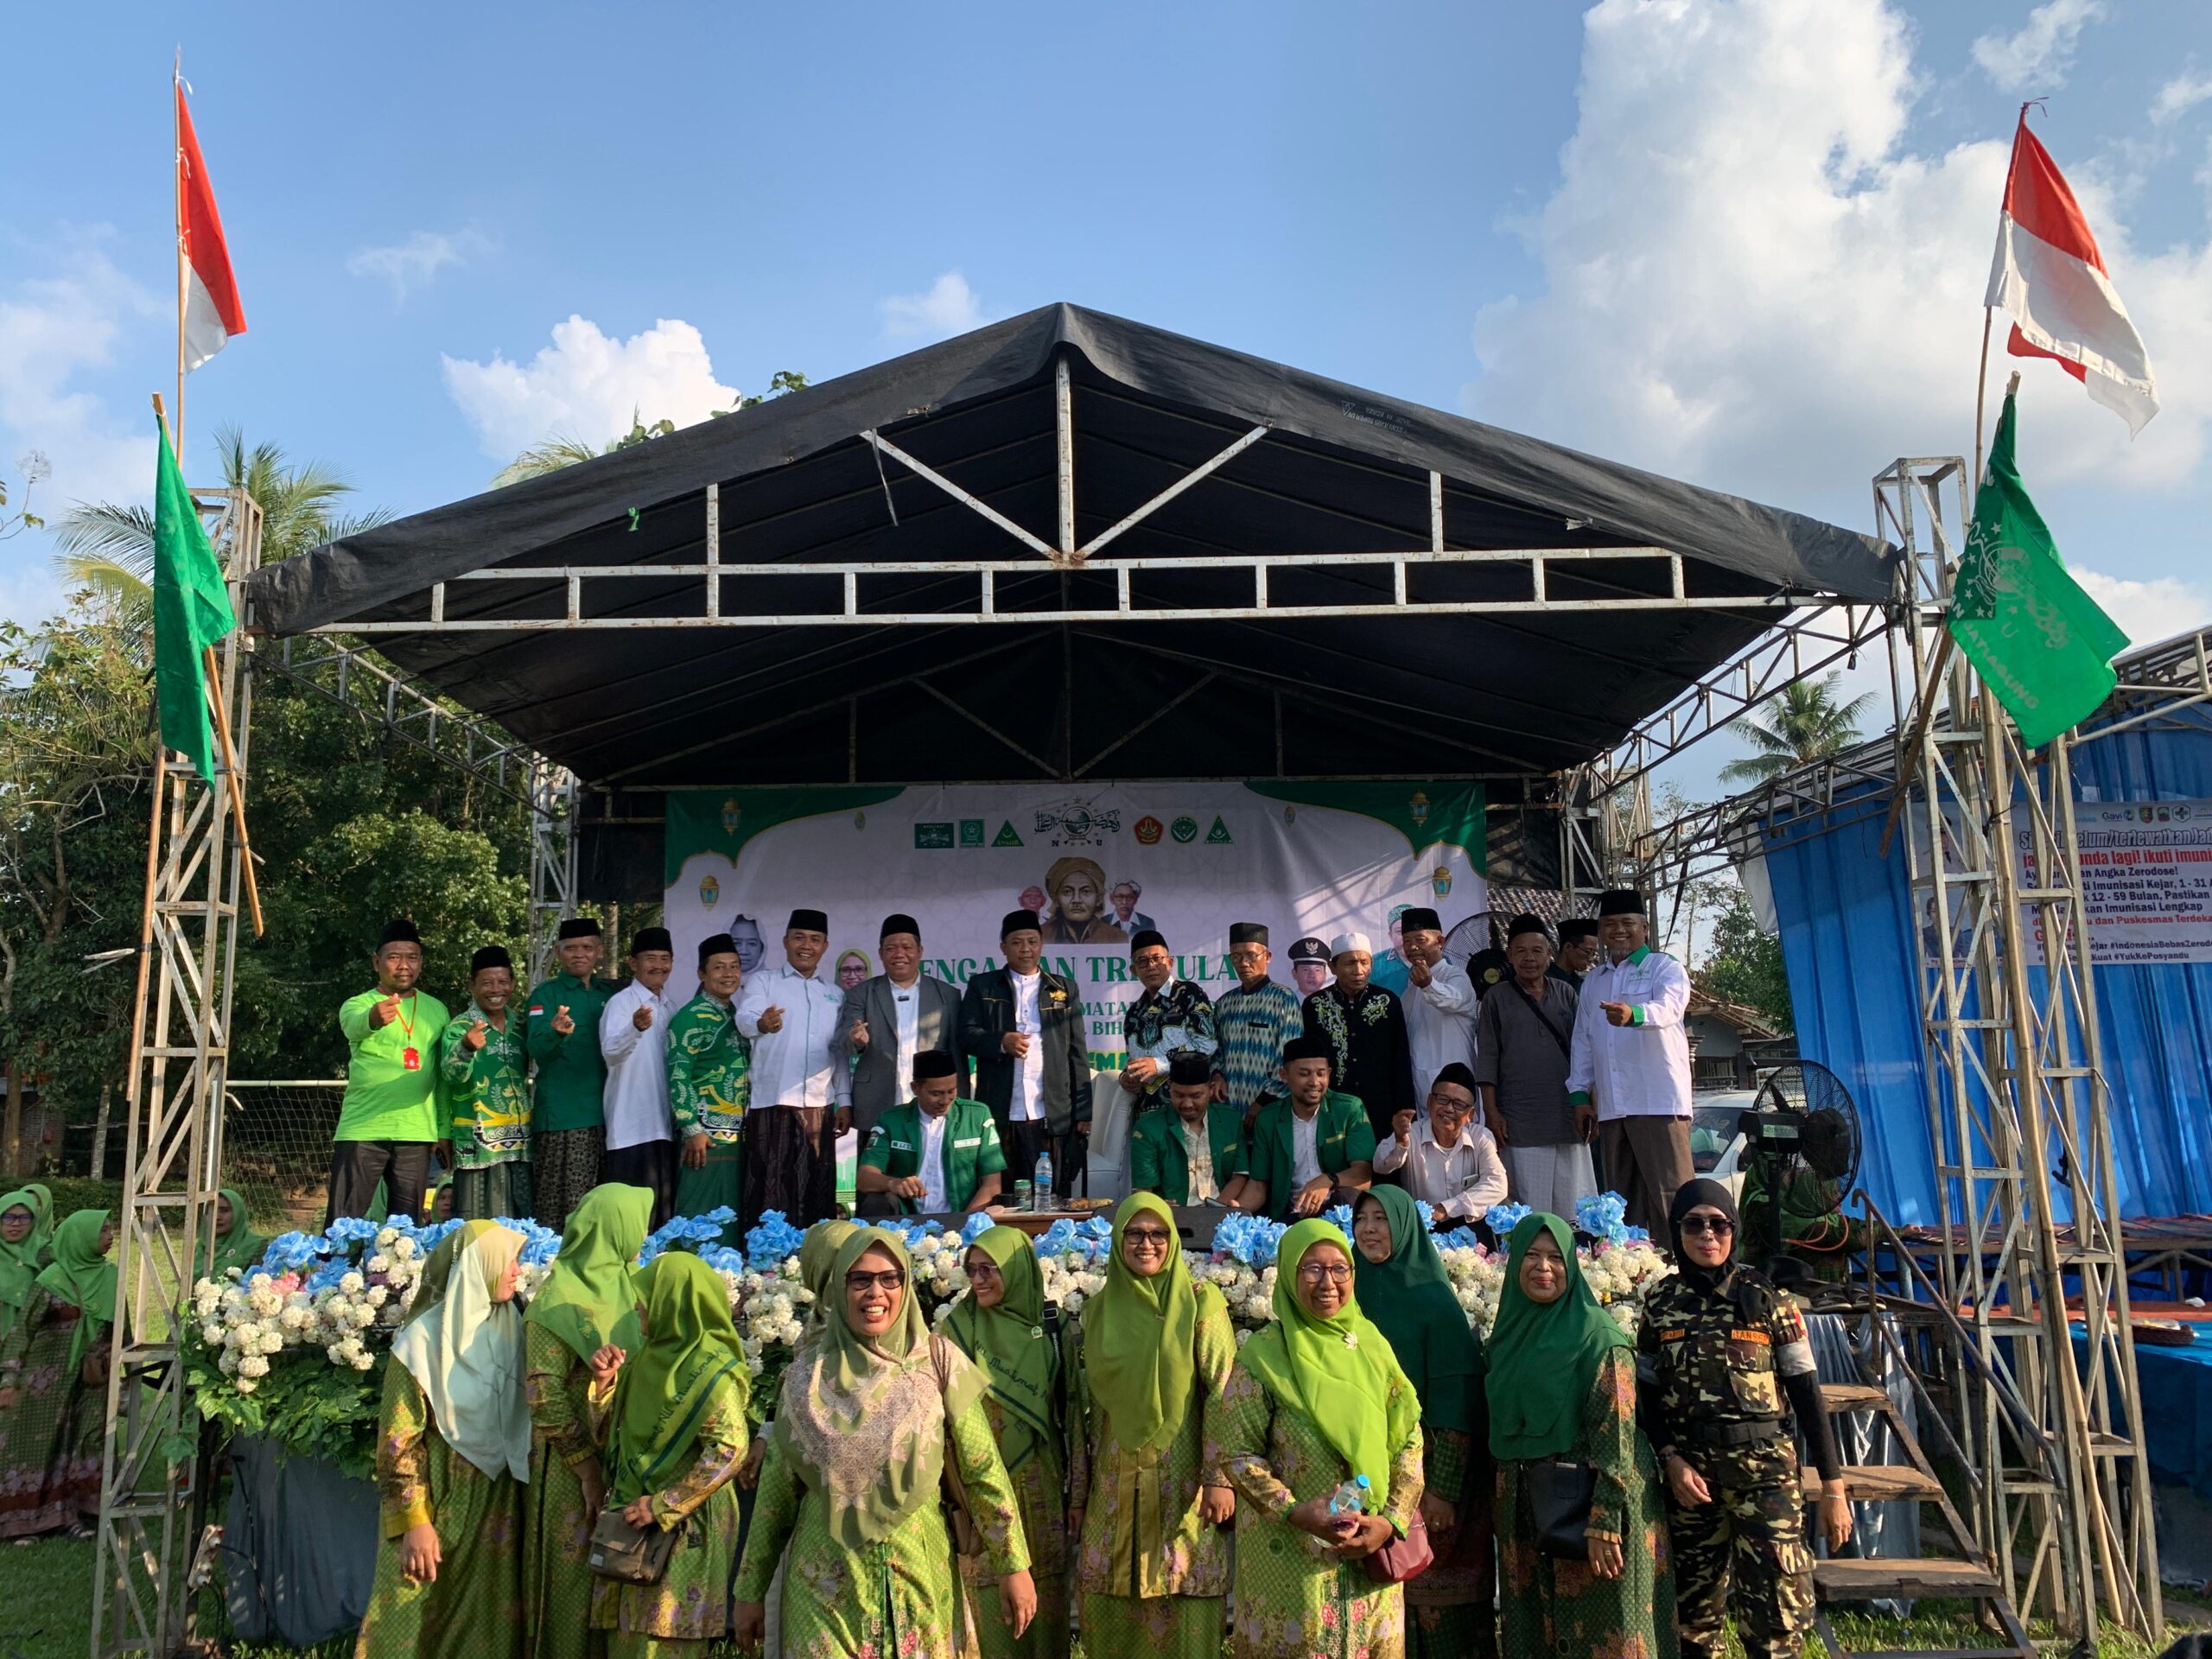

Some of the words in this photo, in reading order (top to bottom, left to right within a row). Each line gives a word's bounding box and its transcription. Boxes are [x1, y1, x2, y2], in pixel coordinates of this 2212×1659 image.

[2101, 811, 2123, 820] Gavi
[2079, 851, 2109, 866] unda
[2111, 849, 2140, 866] lagi!
[2143, 849, 2173, 863] ikuti
[2094, 867, 2126, 879] Angka
[2128, 866, 2178, 876] Zerodose!
[2094, 880, 2145, 890] Imunisasi
[2147, 879, 2177, 891] Kejar,
[2180, 879, 2186, 888] 1
[2194, 878, 2207, 887] 31
[2091, 893, 2104, 902] 12
[2113, 891, 2126, 900] 59
[2129, 891, 2163, 901] Bulan,
[2164, 890, 2210, 899] Pastikan
[2106, 902, 2156, 913] Imunisasi
[2159, 901, 2202, 912] Lengkap
[2095, 917, 2113, 925] dan
[2116, 915, 2174, 925] Puskesmas
[2114, 952, 2190, 961] #YukKePosyandu
